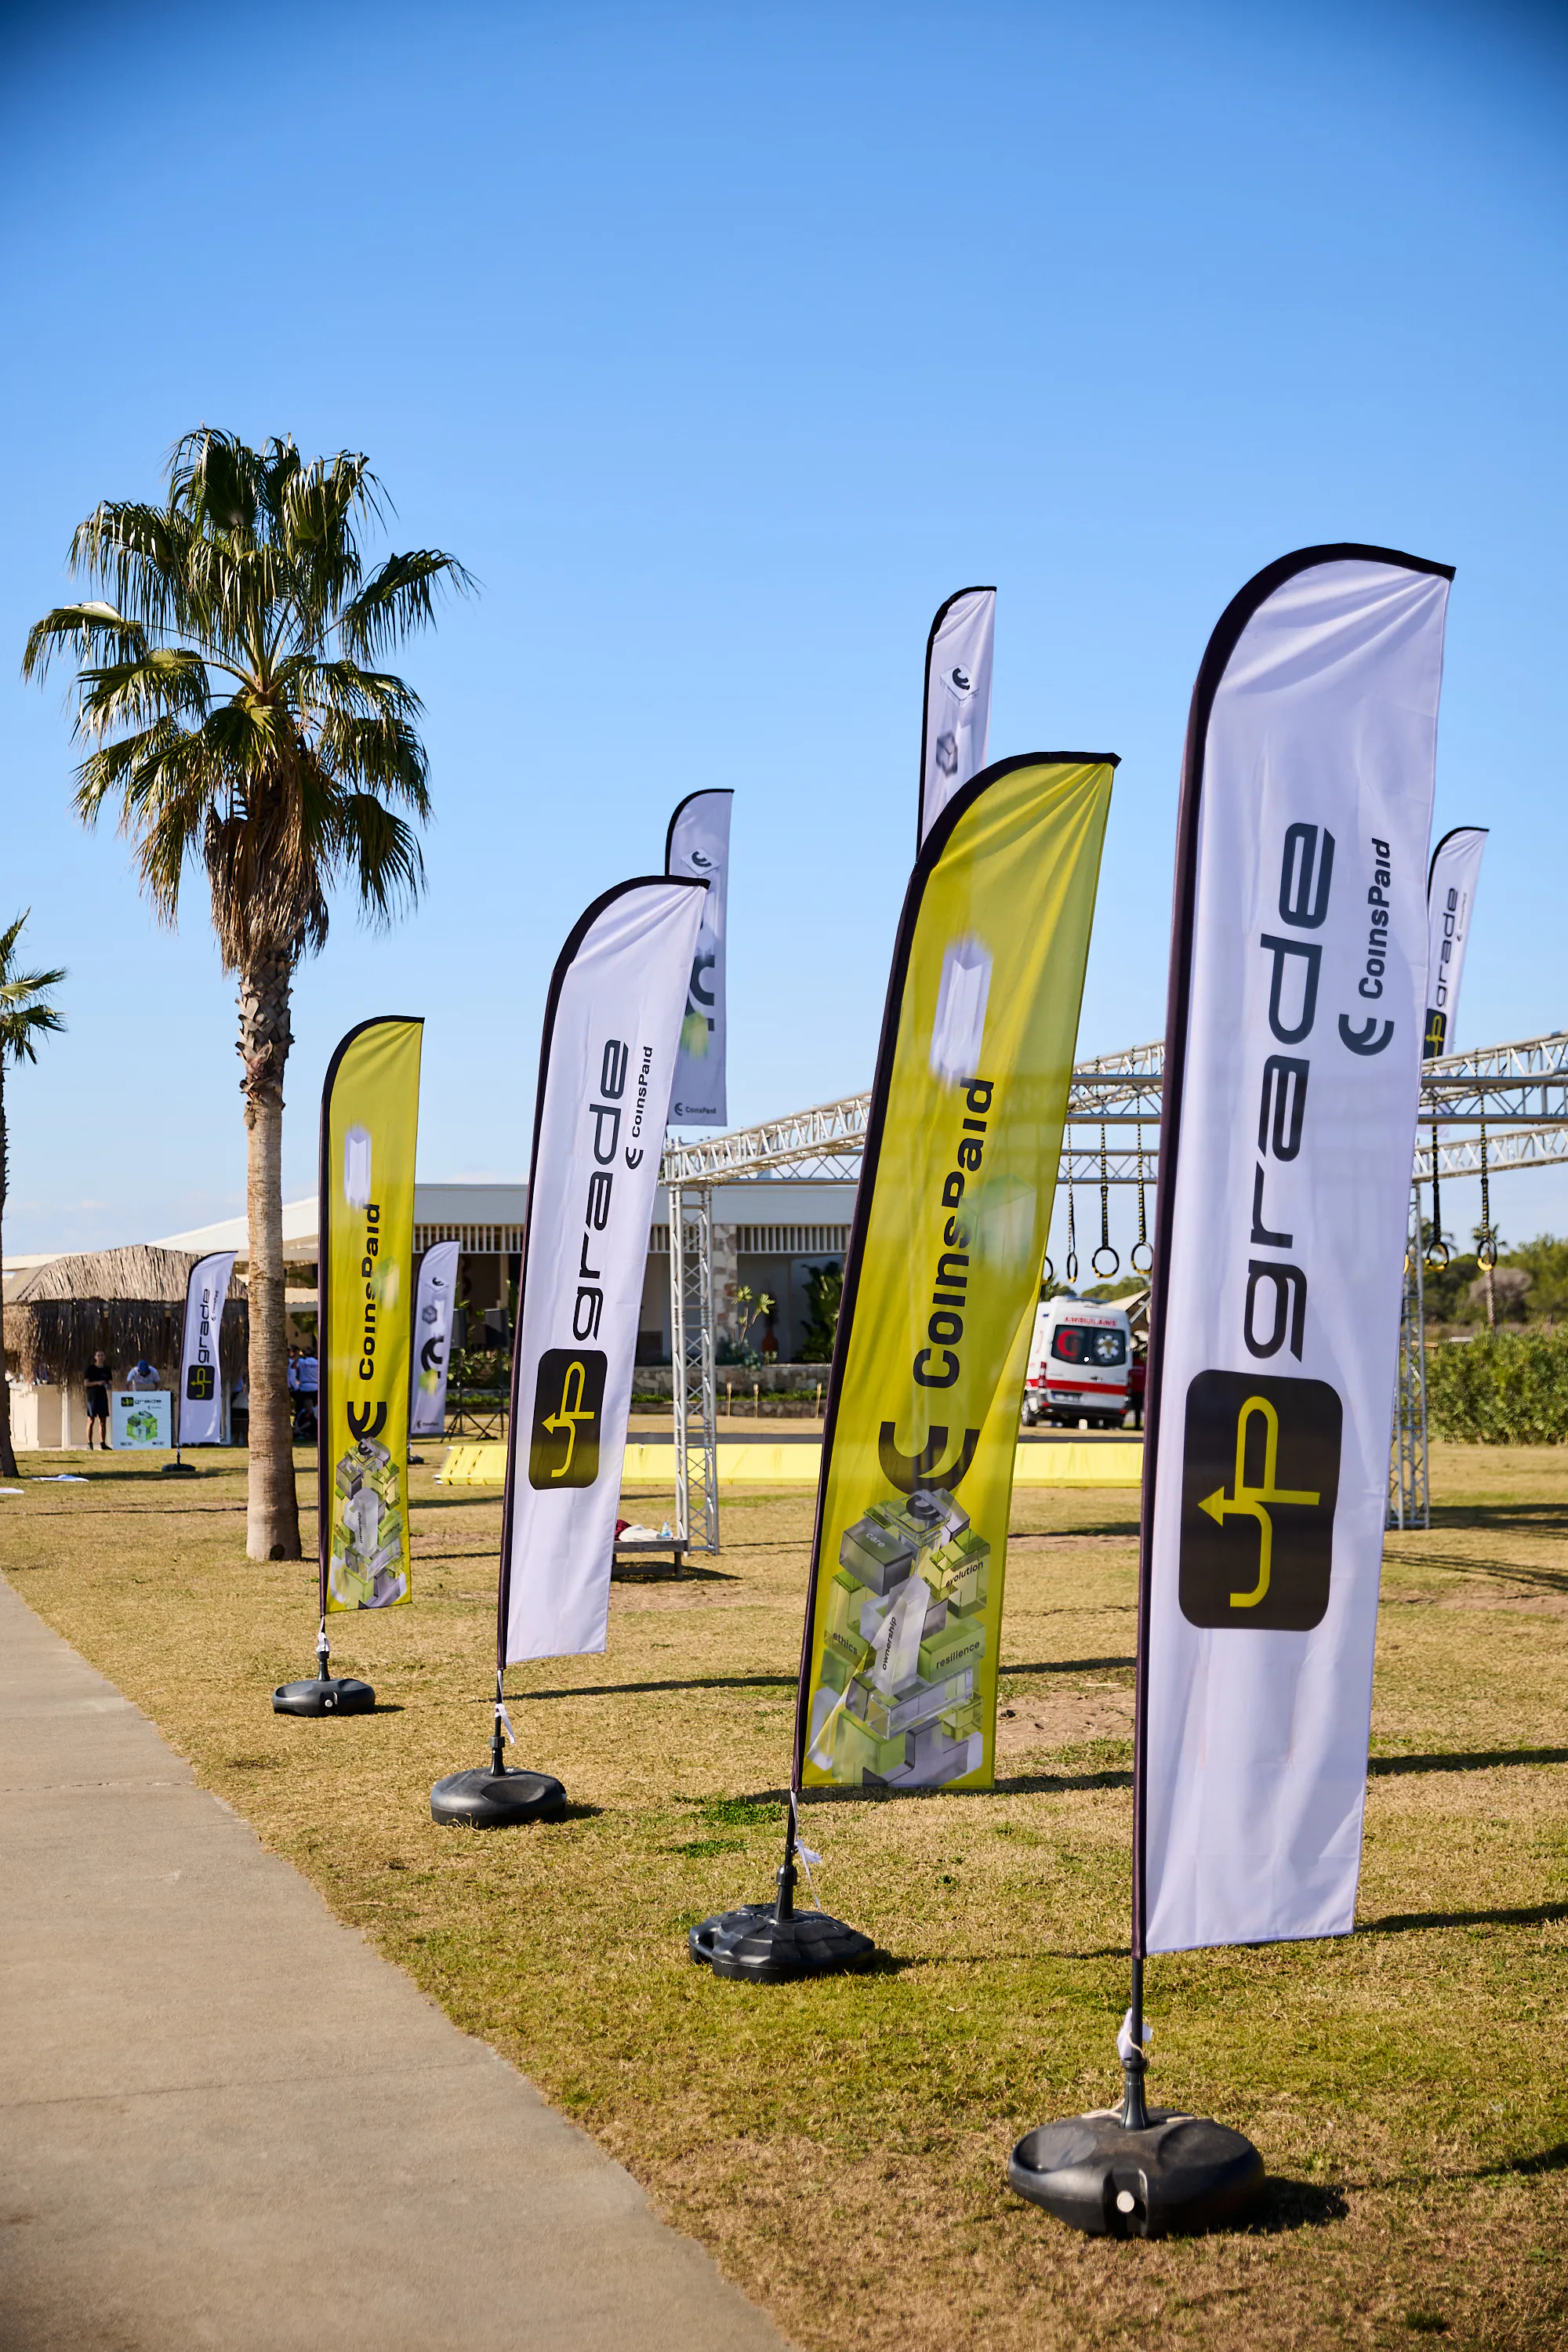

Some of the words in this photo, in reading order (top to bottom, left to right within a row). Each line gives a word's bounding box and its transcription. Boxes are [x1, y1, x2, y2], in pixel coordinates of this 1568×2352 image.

[1357, 837, 1392, 1000] CoinsPaid
[631, 1046, 653, 1138] CoinsPaid
[913, 1076, 994, 1389] CoinsPaid
[359, 1203, 380, 1381] CoinsPaid
[866, 1532, 885, 1548] care
[946, 1562, 984, 1587] evolution
[833, 1632, 858, 1656] ethics
[882, 1617, 897, 1671] ownership
[935, 1641, 980, 1670] resilience
